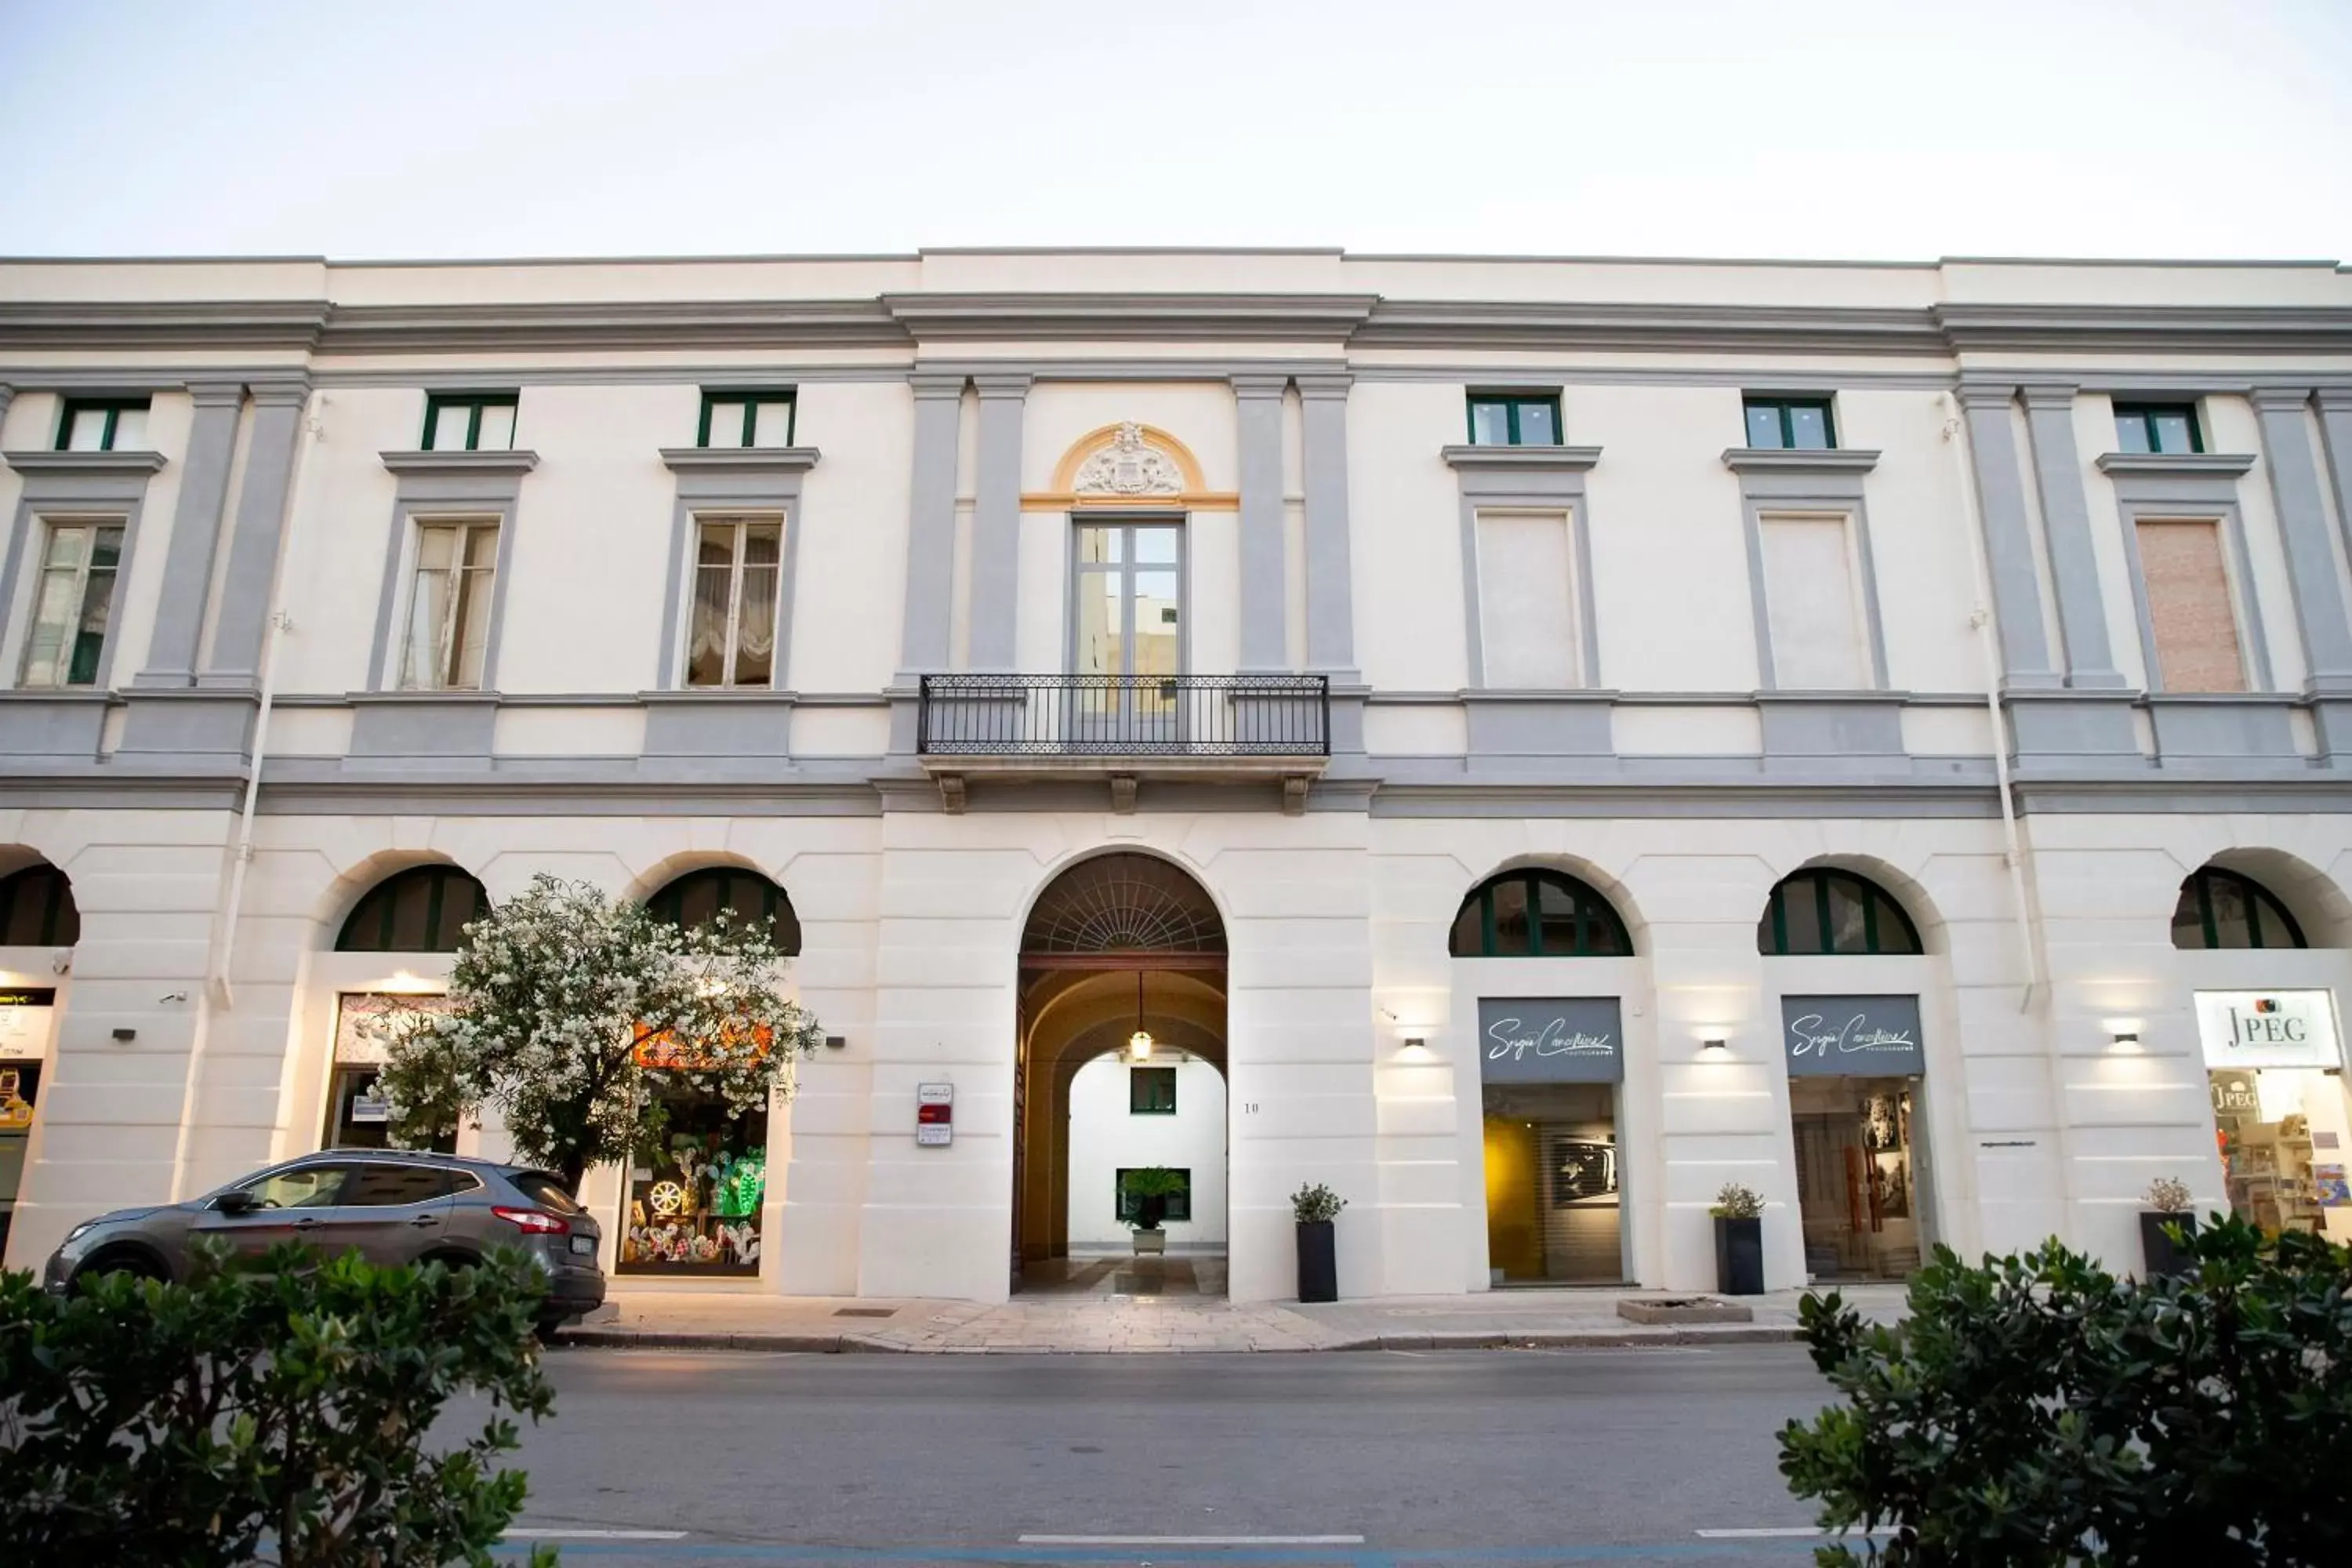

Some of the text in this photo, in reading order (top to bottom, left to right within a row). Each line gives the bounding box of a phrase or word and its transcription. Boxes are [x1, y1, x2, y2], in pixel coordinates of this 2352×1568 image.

[2227, 1007, 2306, 1047] JPEG
[1245, 1103, 1258, 1114] 10
[2216, 1083, 2257, 1109] JPEG
